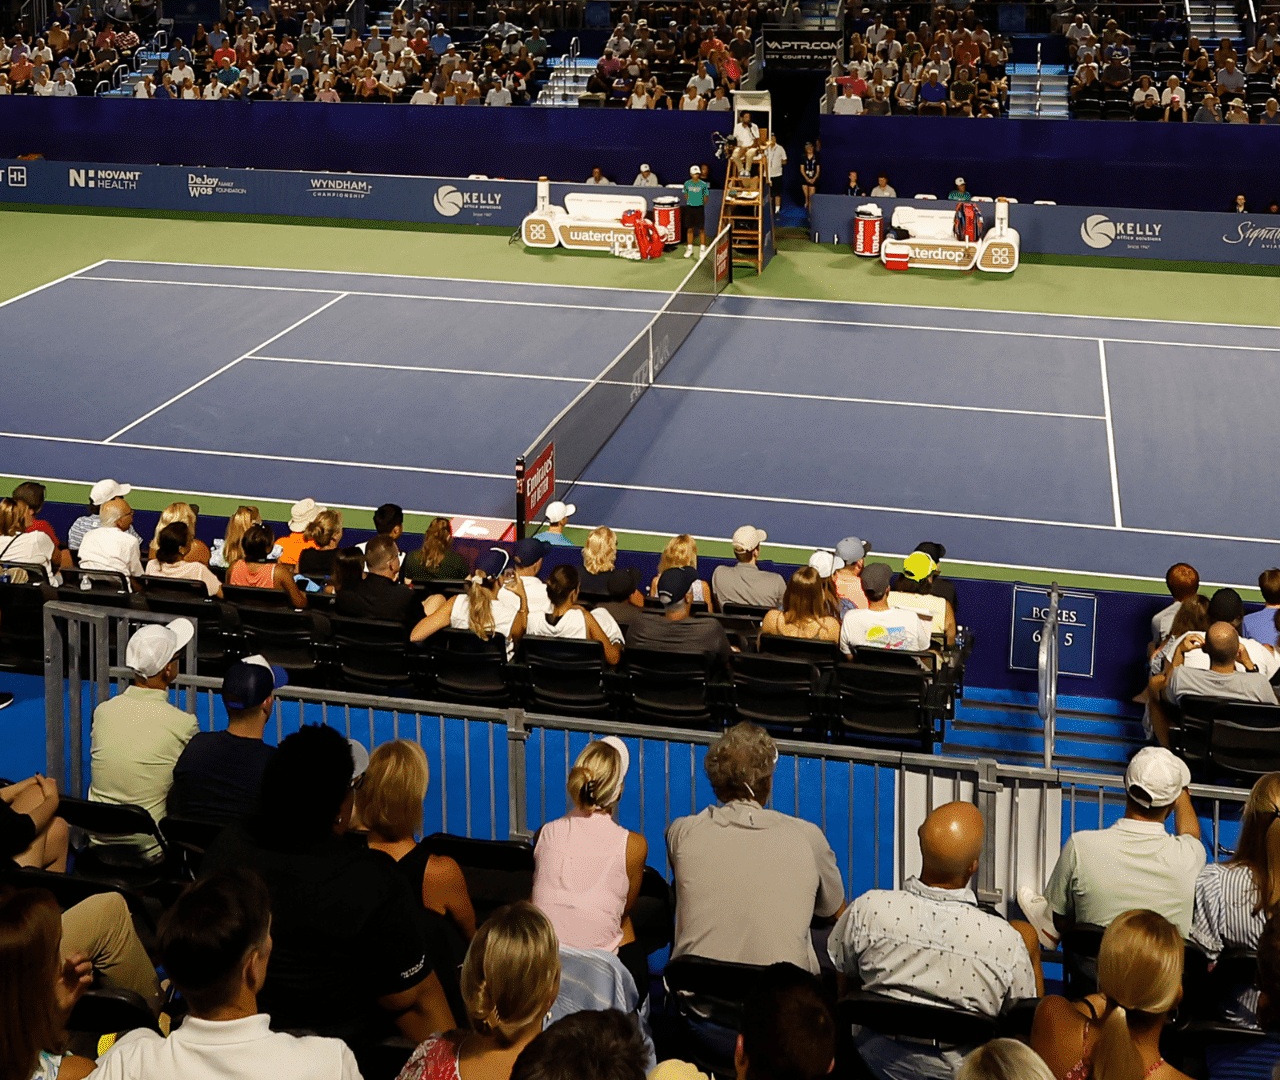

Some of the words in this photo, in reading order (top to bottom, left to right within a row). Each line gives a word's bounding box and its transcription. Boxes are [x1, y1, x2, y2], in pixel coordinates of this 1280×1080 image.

[97, 169, 141, 181] NOVANT
[188, 173, 218, 188] DeJoy
[97, 179, 136, 190] HEALTH
[311, 178, 367, 191] WYNDHAM
[188, 186, 213, 198] Wos
[312, 191, 365, 199] CHAMPIONSHIP
[463, 192, 502, 205] KELLY
[1116, 222, 1162, 236] KELLY
[570, 230, 634, 244] waterdrop
[855, 220, 865, 253] Wilson
[910, 247, 964, 263] terdrop
[526, 455, 553, 498] Emirates
[537, 475, 549, 502] BETTER
[1032, 629, 1041, 643] 6
[1064, 632, 1074, 646] 5
